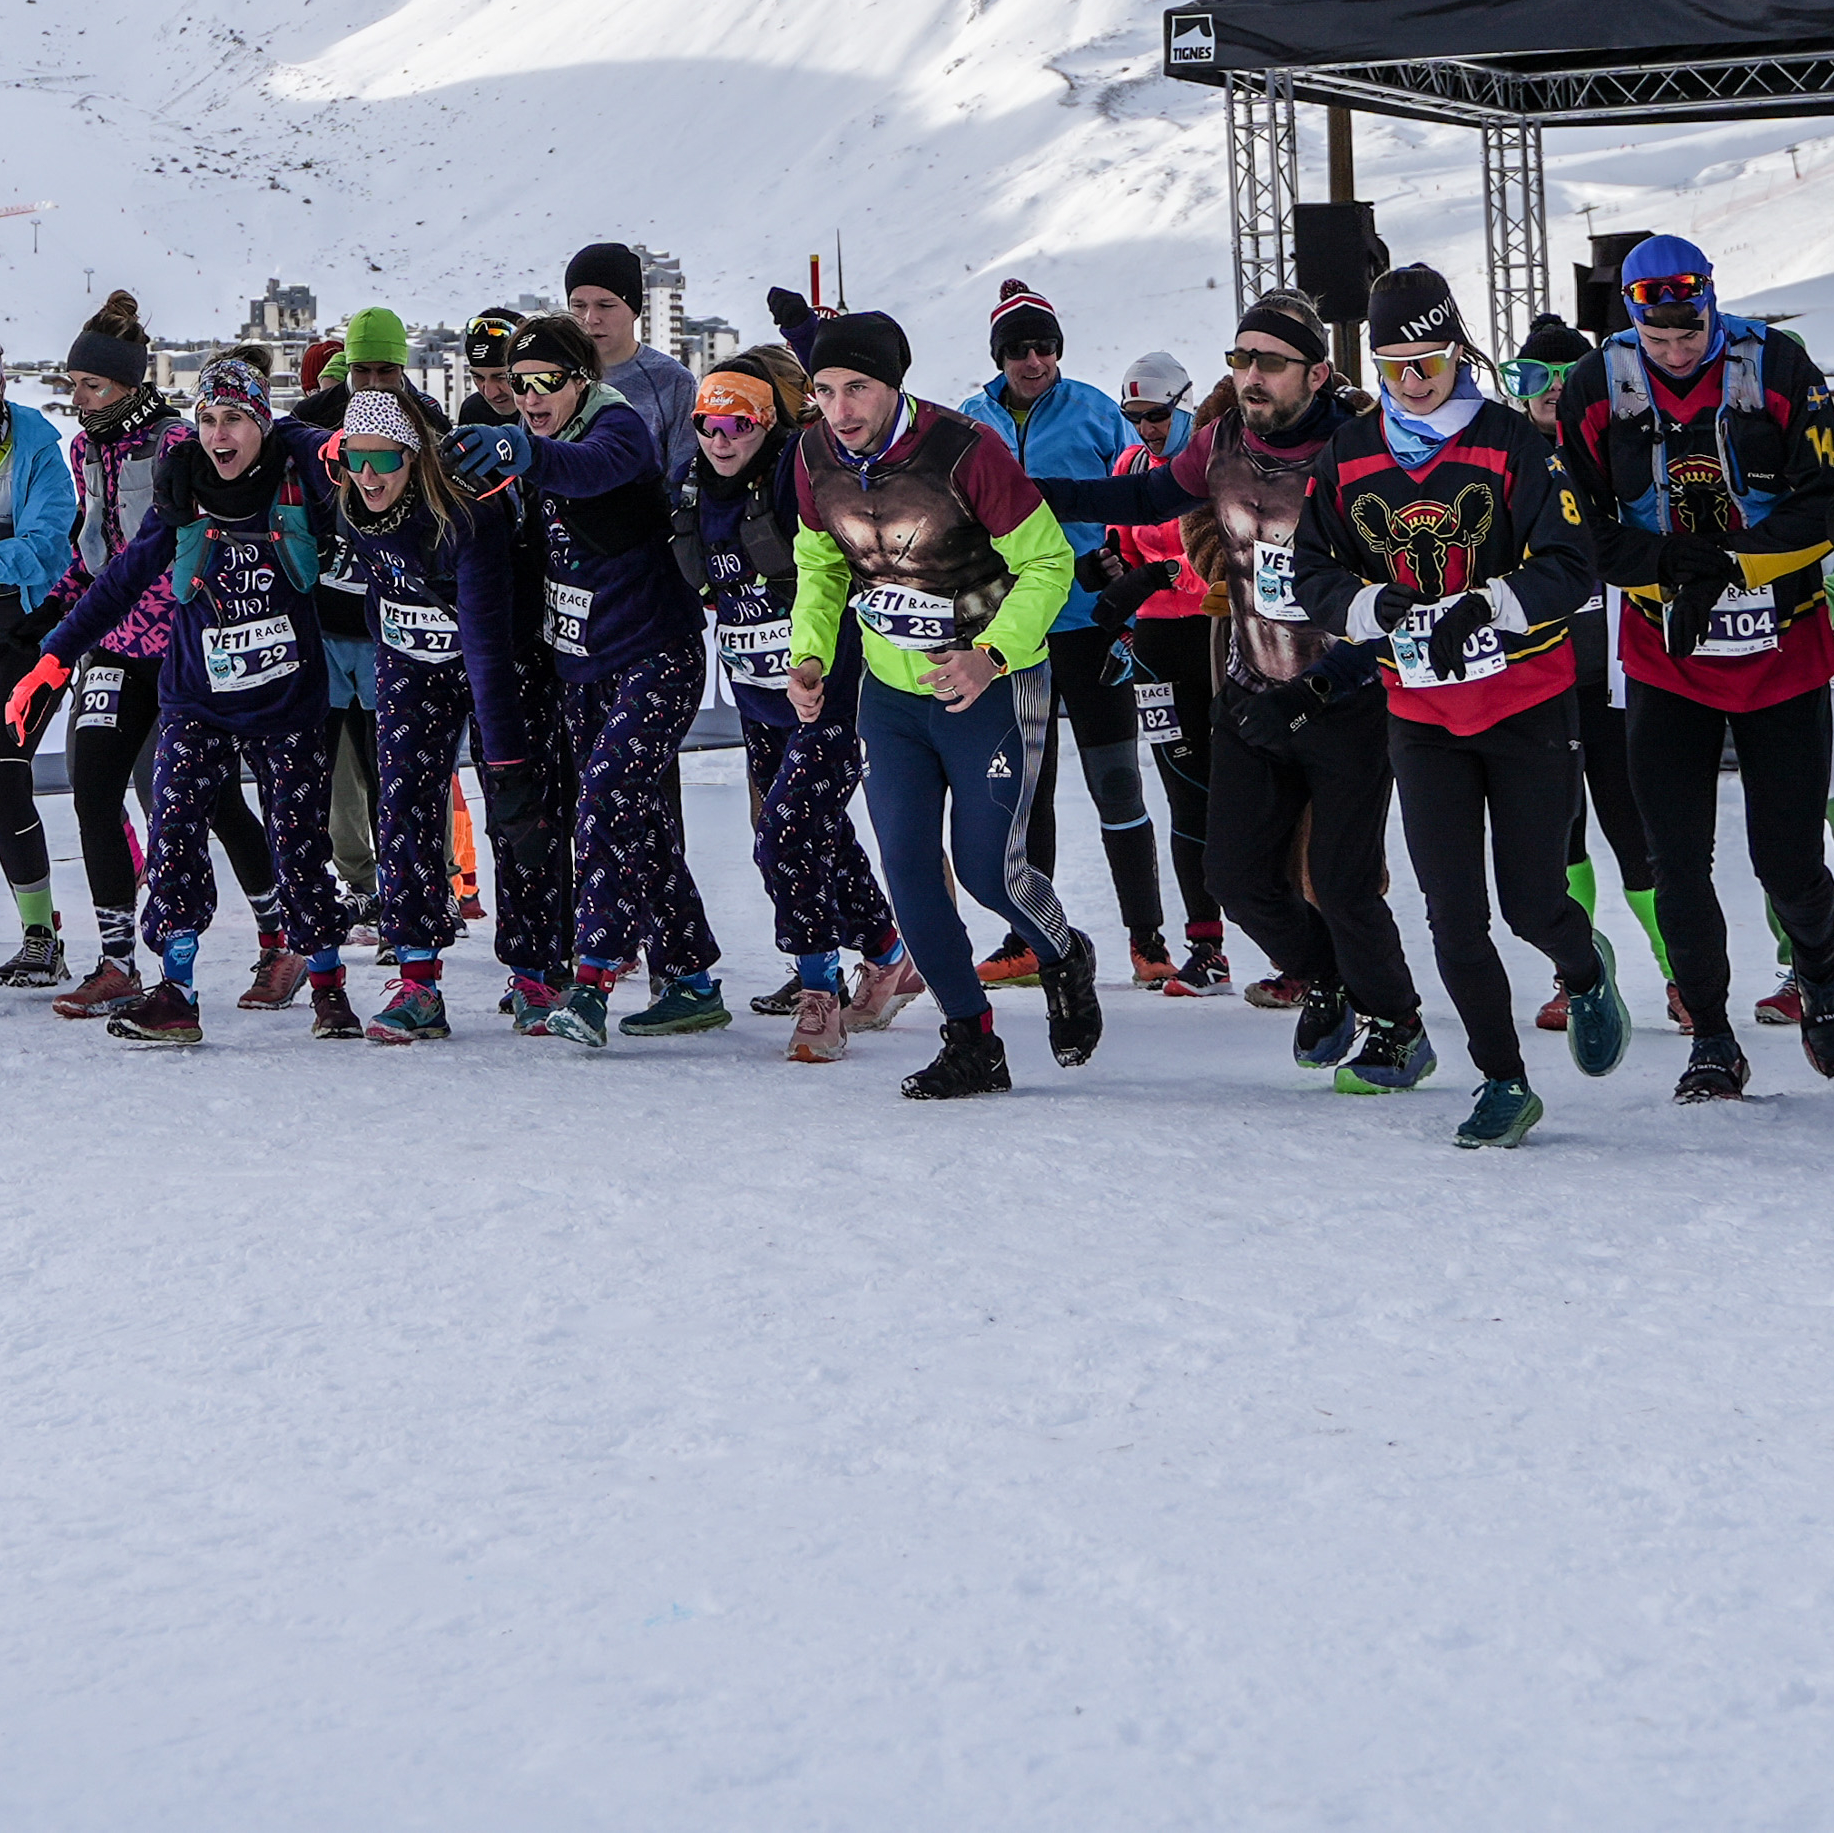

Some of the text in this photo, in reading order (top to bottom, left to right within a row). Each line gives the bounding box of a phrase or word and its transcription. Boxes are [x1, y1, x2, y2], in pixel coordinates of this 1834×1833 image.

[1172, 46, 1213, 62] TIGNES
[122, 398, 160, 433] PEAK
[1559, 489, 1582, 526] 8
[1261, 550, 1295, 573] YÉT
[559, 591, 588, 610] RACE
[421, 612, 450, 624] RAC
[558, 616, 580, 640] 28
[908, 617, 943, 637] 23
[1720, 611, 1774, 637] 104
[255, 621, 289, 641] RACE
[424, 632, 453, 650] 27
[1463, 626, 1498, 658] 03
[259, 644, 288, 669] 29
[89, 668, 120, 684] RACE
[84, 692, 109, 711] 90
[1141, 687, 1170, 701] RACE
[1145, 708, 1171, 729] 82
